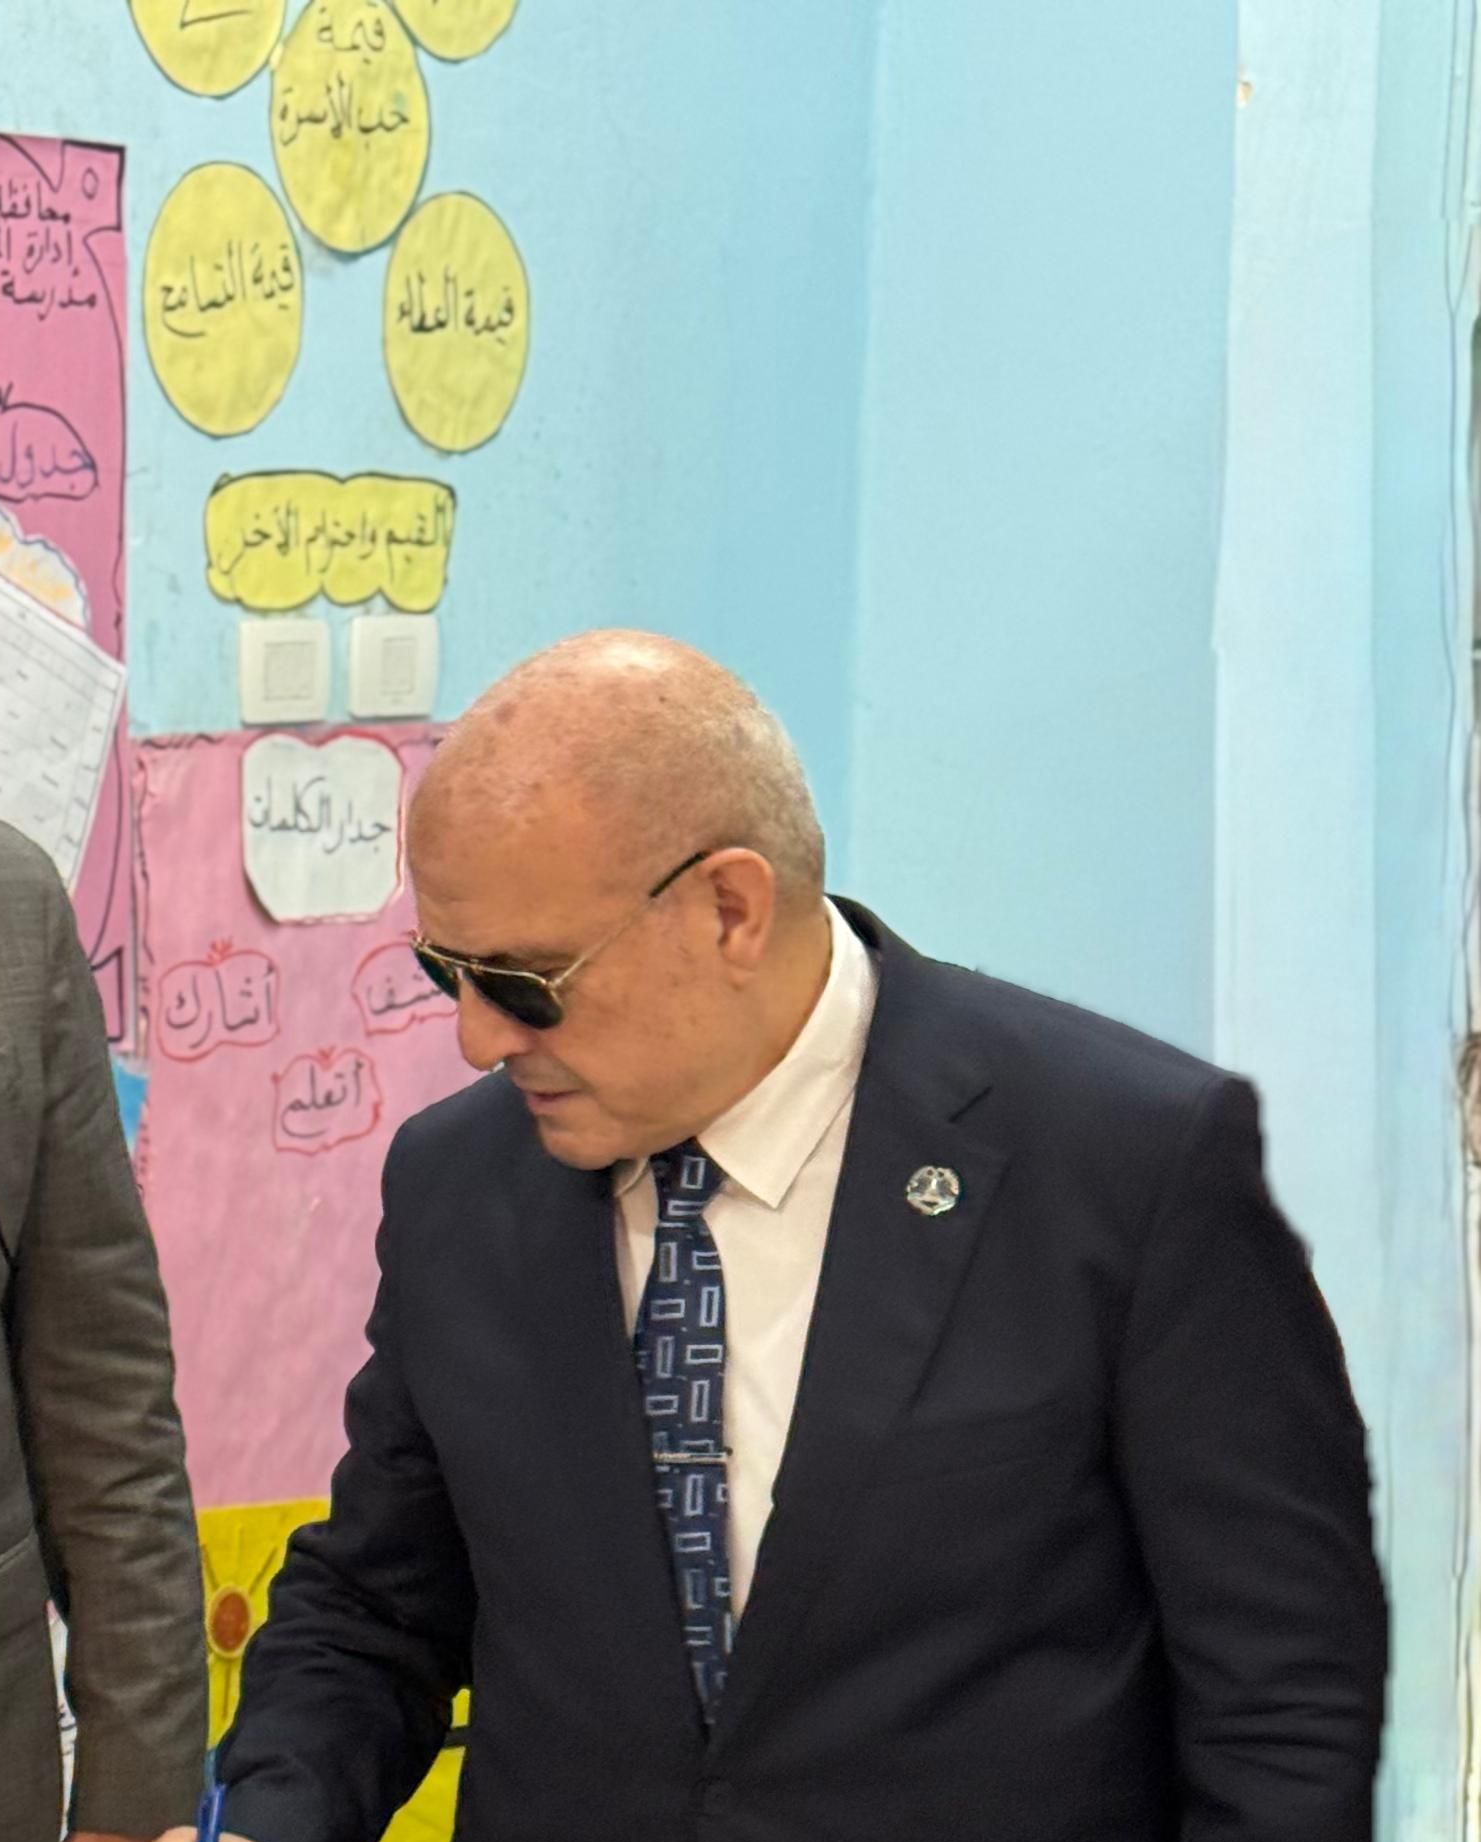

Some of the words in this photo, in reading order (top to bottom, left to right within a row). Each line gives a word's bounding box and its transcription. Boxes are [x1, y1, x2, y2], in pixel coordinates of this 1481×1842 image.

[322, 799, 392, 854] جدار
[165, 960, 276, 1050] أشارك
[281, 1059, 364, 1138] أتعلم
